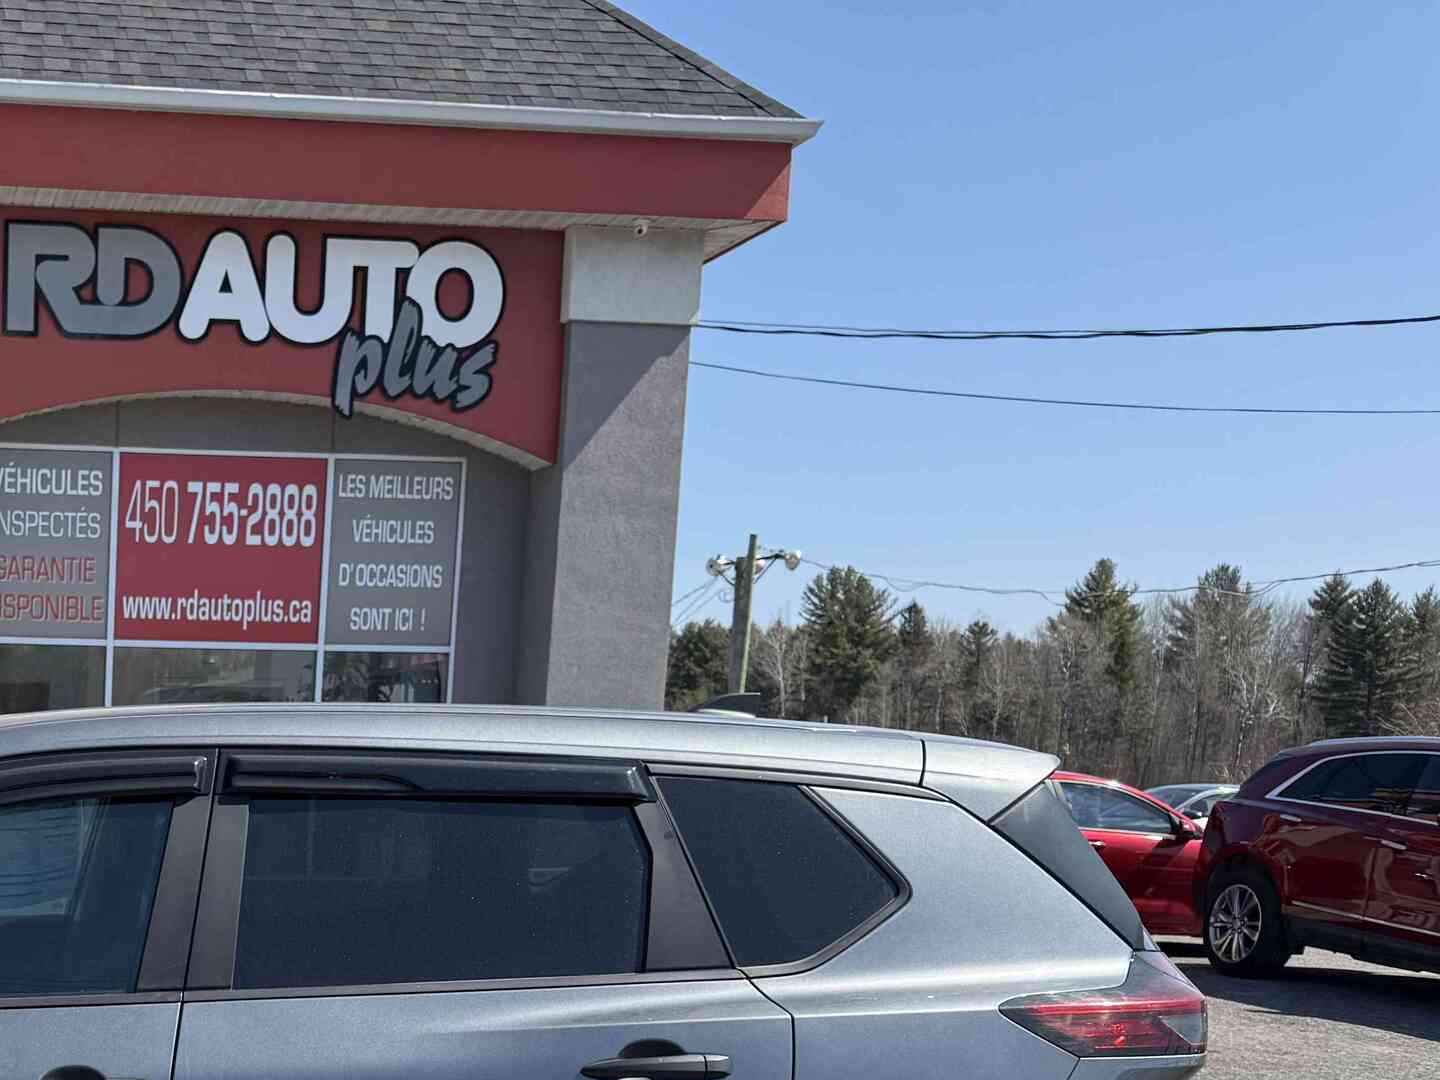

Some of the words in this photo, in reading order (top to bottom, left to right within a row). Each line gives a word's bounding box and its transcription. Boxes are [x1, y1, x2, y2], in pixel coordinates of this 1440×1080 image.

[332, 296, 498, 417] plus
[338, 473, 366, 498] LES
[369, 475, 454, 500] MEILLEURS
[125, 479, 179, 544] 450
[187, 480, 318, 547] 755-2888
[352, 513, 434, 544] VÉHICULES
[122, 588, 312, 630] www.rdautoplus.ca
[350, 607, 392, 631] SONT
